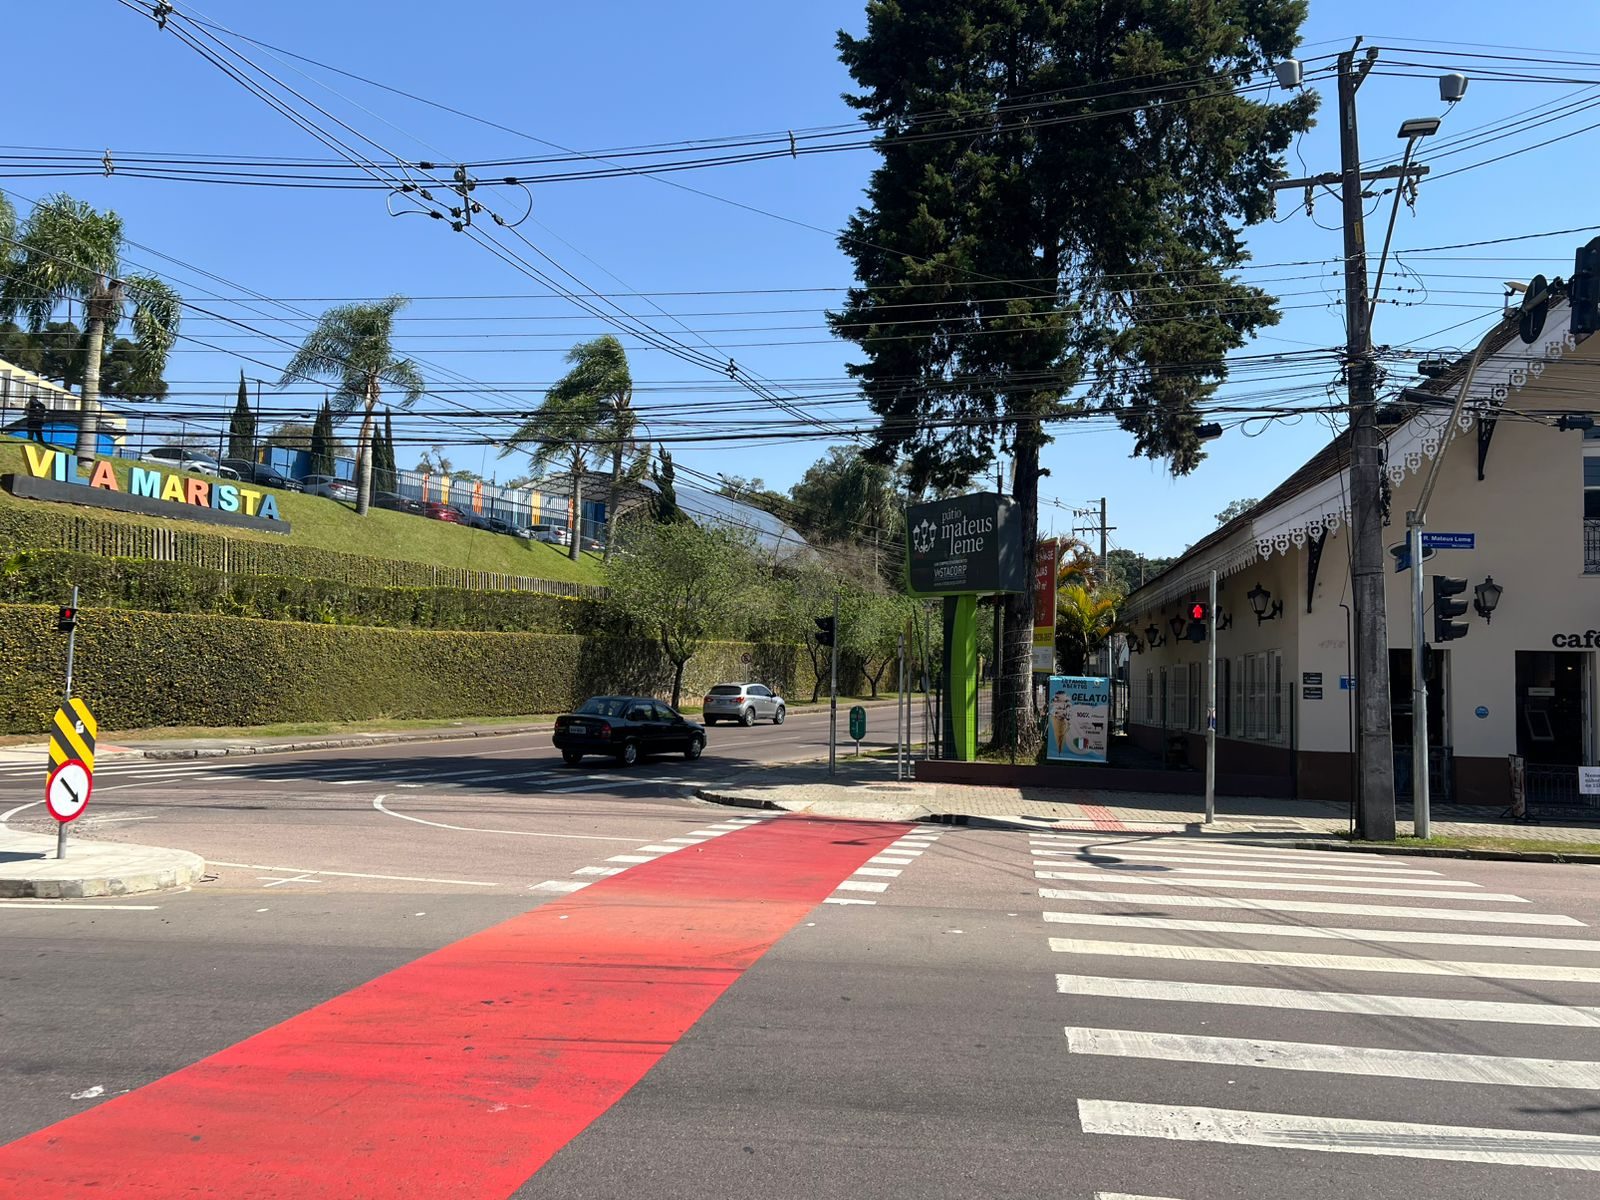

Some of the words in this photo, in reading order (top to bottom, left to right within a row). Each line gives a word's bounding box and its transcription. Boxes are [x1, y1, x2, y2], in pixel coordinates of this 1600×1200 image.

[21, 444, 119, 491] VILA
[128, 467, 282, 520] MARISTA
[941, 507, 962, 524] pátio
[941, 515, 993, 539] mateus
[950, 536, 984, 555] leme
[1071, 692, 1108, 703] GELATO
